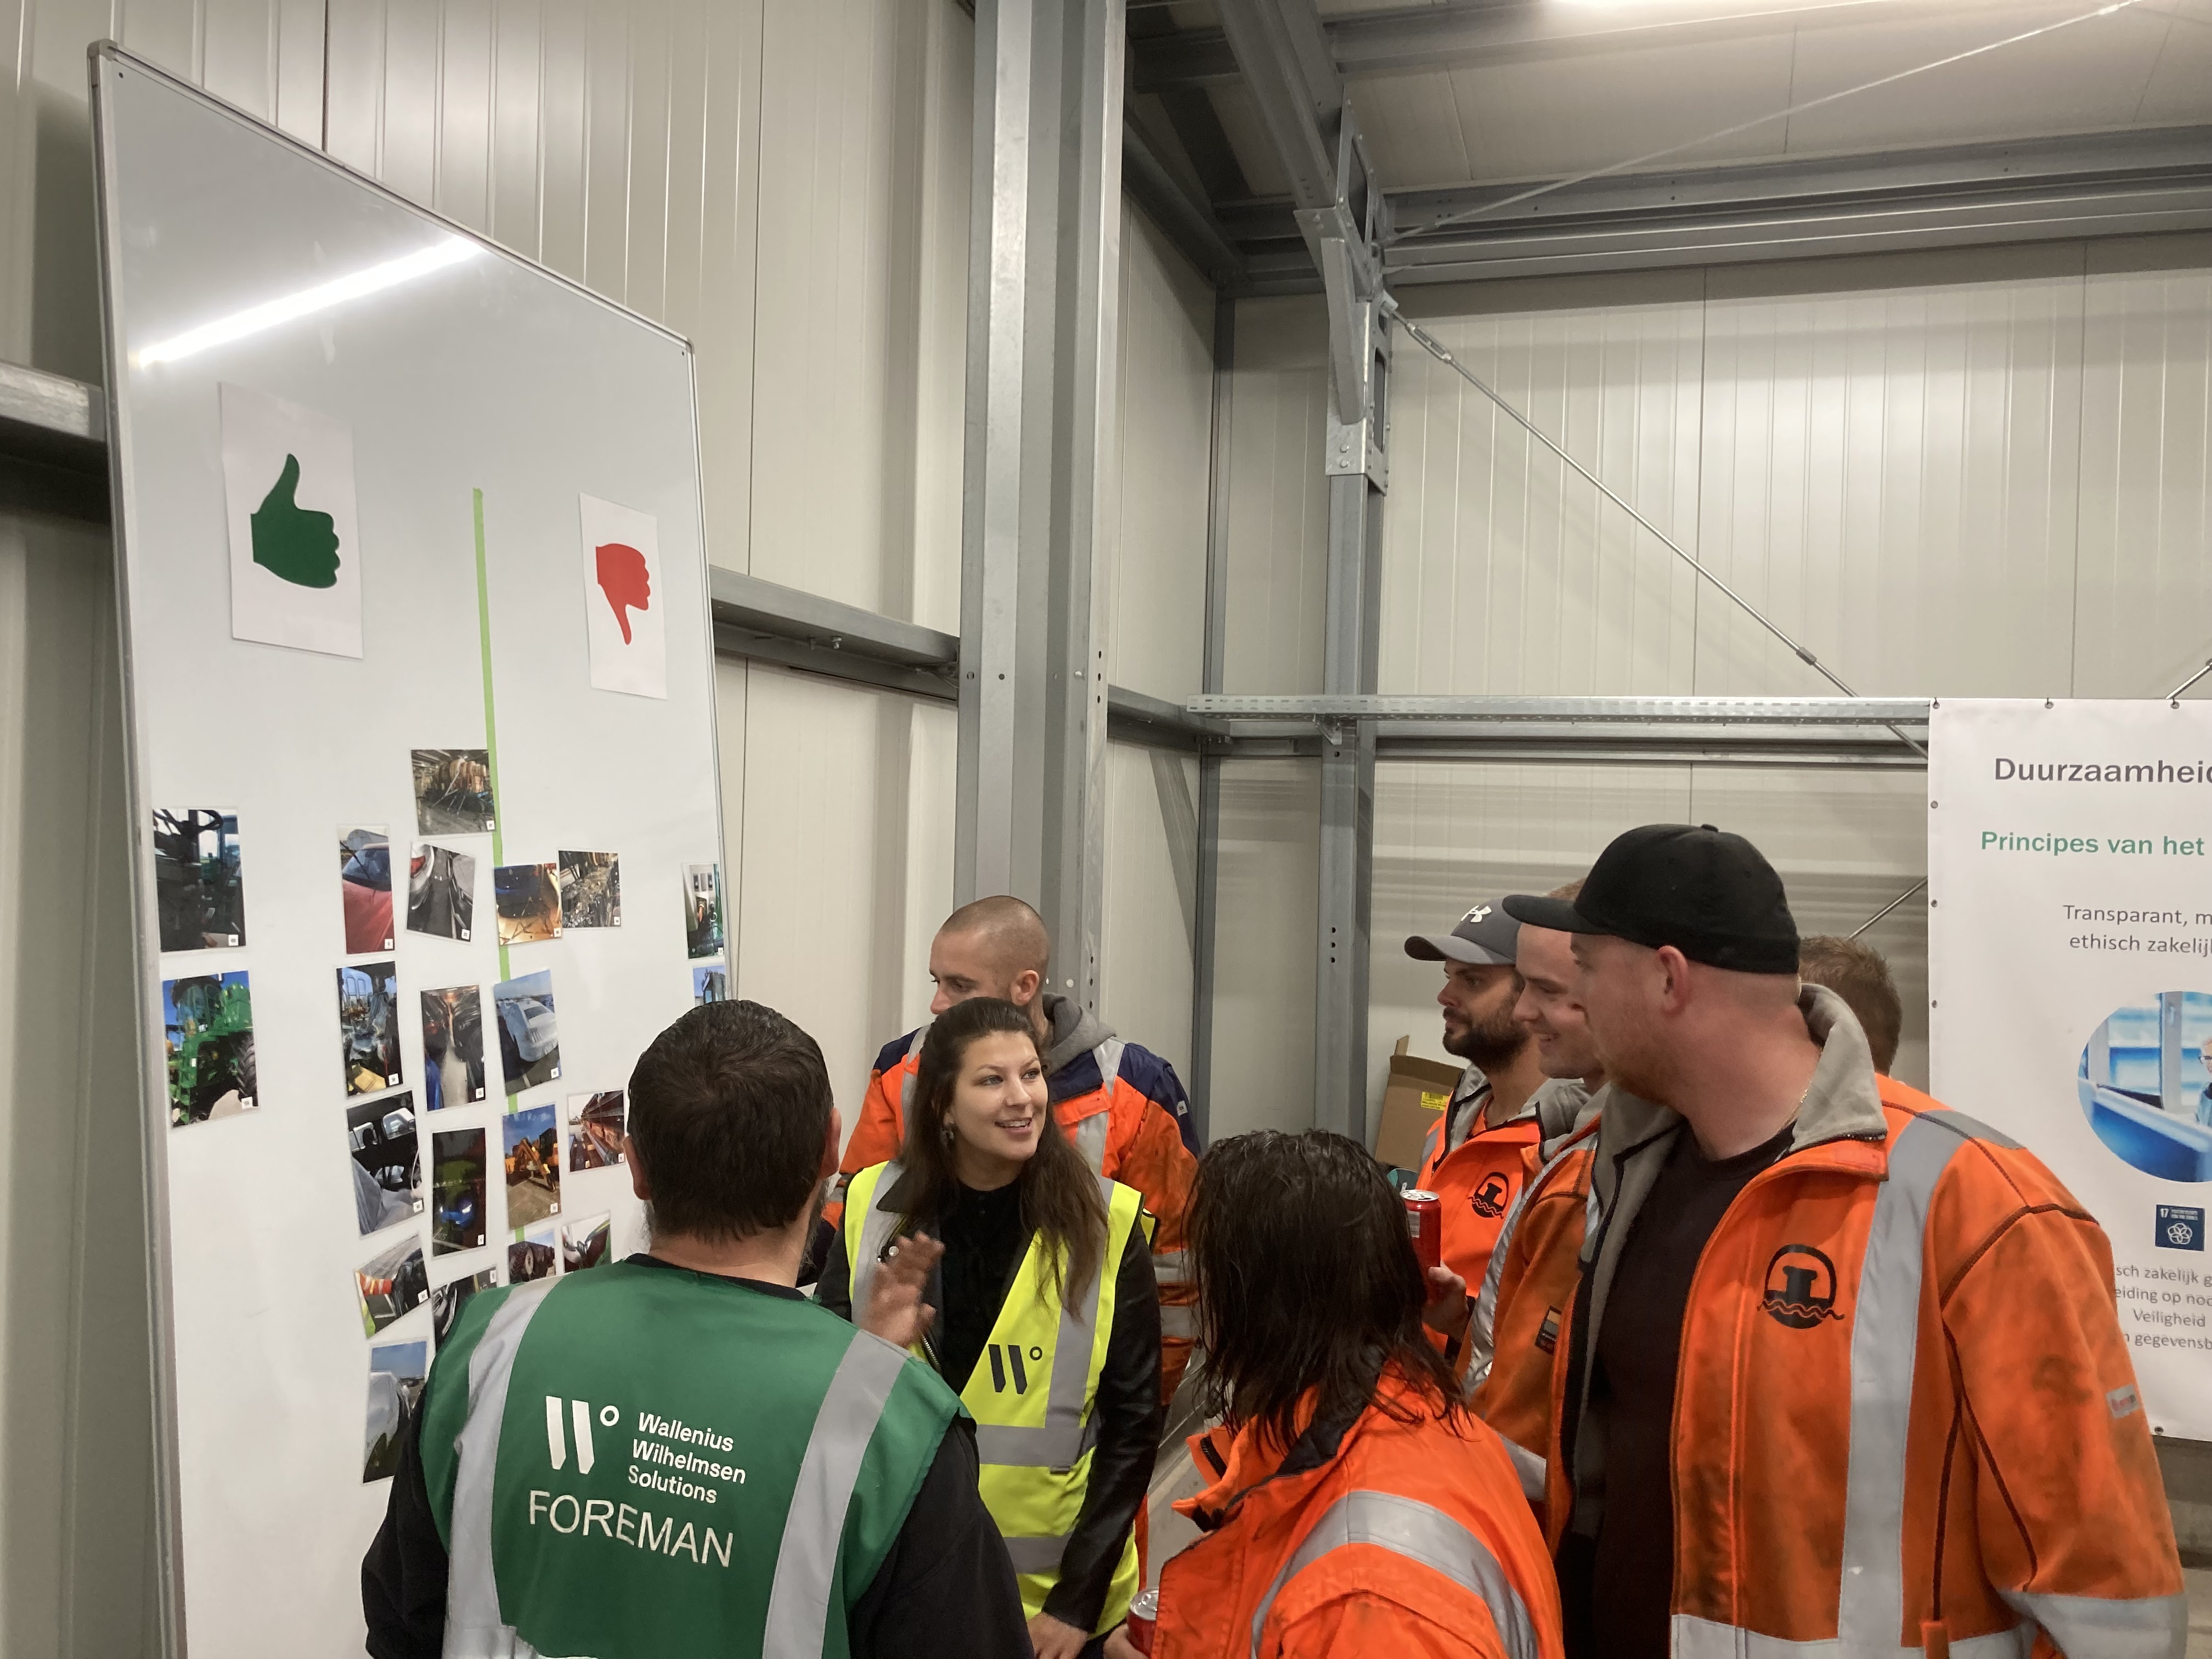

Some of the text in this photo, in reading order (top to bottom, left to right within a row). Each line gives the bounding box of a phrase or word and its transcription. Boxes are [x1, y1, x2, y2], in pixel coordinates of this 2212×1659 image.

[1982, 831, 2205, 856] Principes van het
[2063, 905, 2188, 927] Transparant,
[2069, 934, 2212, 957] ethisch zakelij
[2116, 1265, 2139, 1278] sch
[2145, 1266, 2199, 1285] zakelijk
[2116, 1286, 2158, 1304] eiding
[2162, 1292, 2181, 1305] op
[2132, 1307, 2206, 1328] Veiligheid
[638, 1412, 734, 1452] Wallenius
[633, 1438, 746, 1484] Wilhelmsen
[628, 1464, 717, 1504] Solutions
[530, 1489, 733, 1567] FOREMAN
